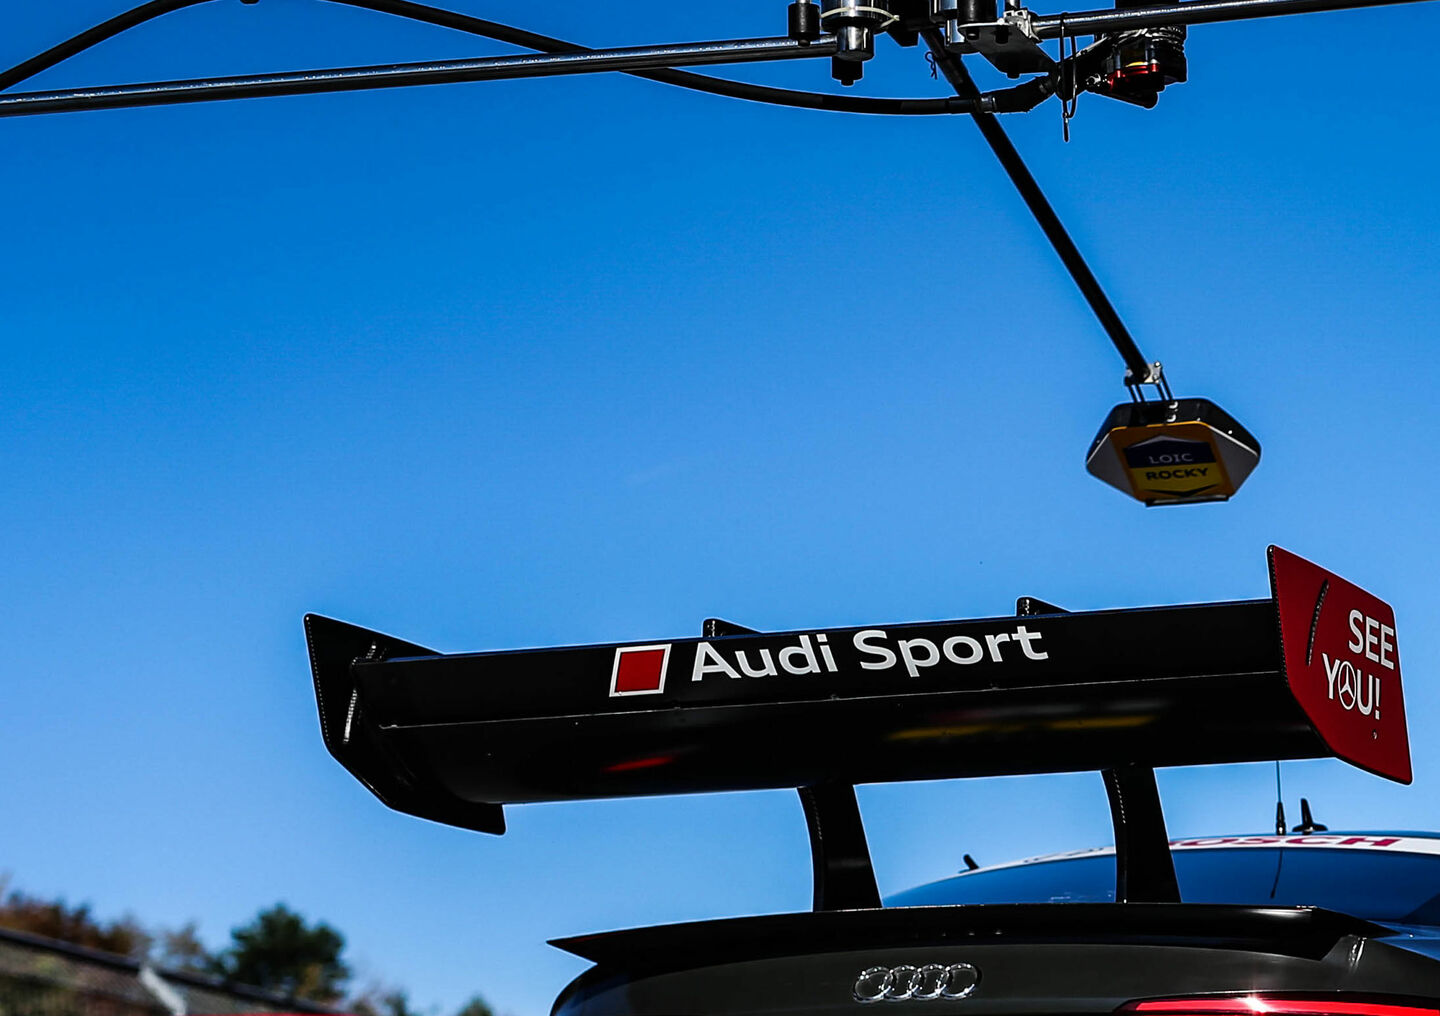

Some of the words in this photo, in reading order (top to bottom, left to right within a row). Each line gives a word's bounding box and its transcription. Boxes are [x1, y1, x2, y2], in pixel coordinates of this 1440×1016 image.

[1145, 467, 1209, 481] ROCKY
[1149, 453, 1194, 464] LOIC
[691, 633, 839, 682] Audi
[852, 626, 1049, 677] Sport
[1348, 609, 1394, 671] SEE
[1322, 652, 1381, 721] YOU!
[1169, 836, 1402, 847] OSCH
